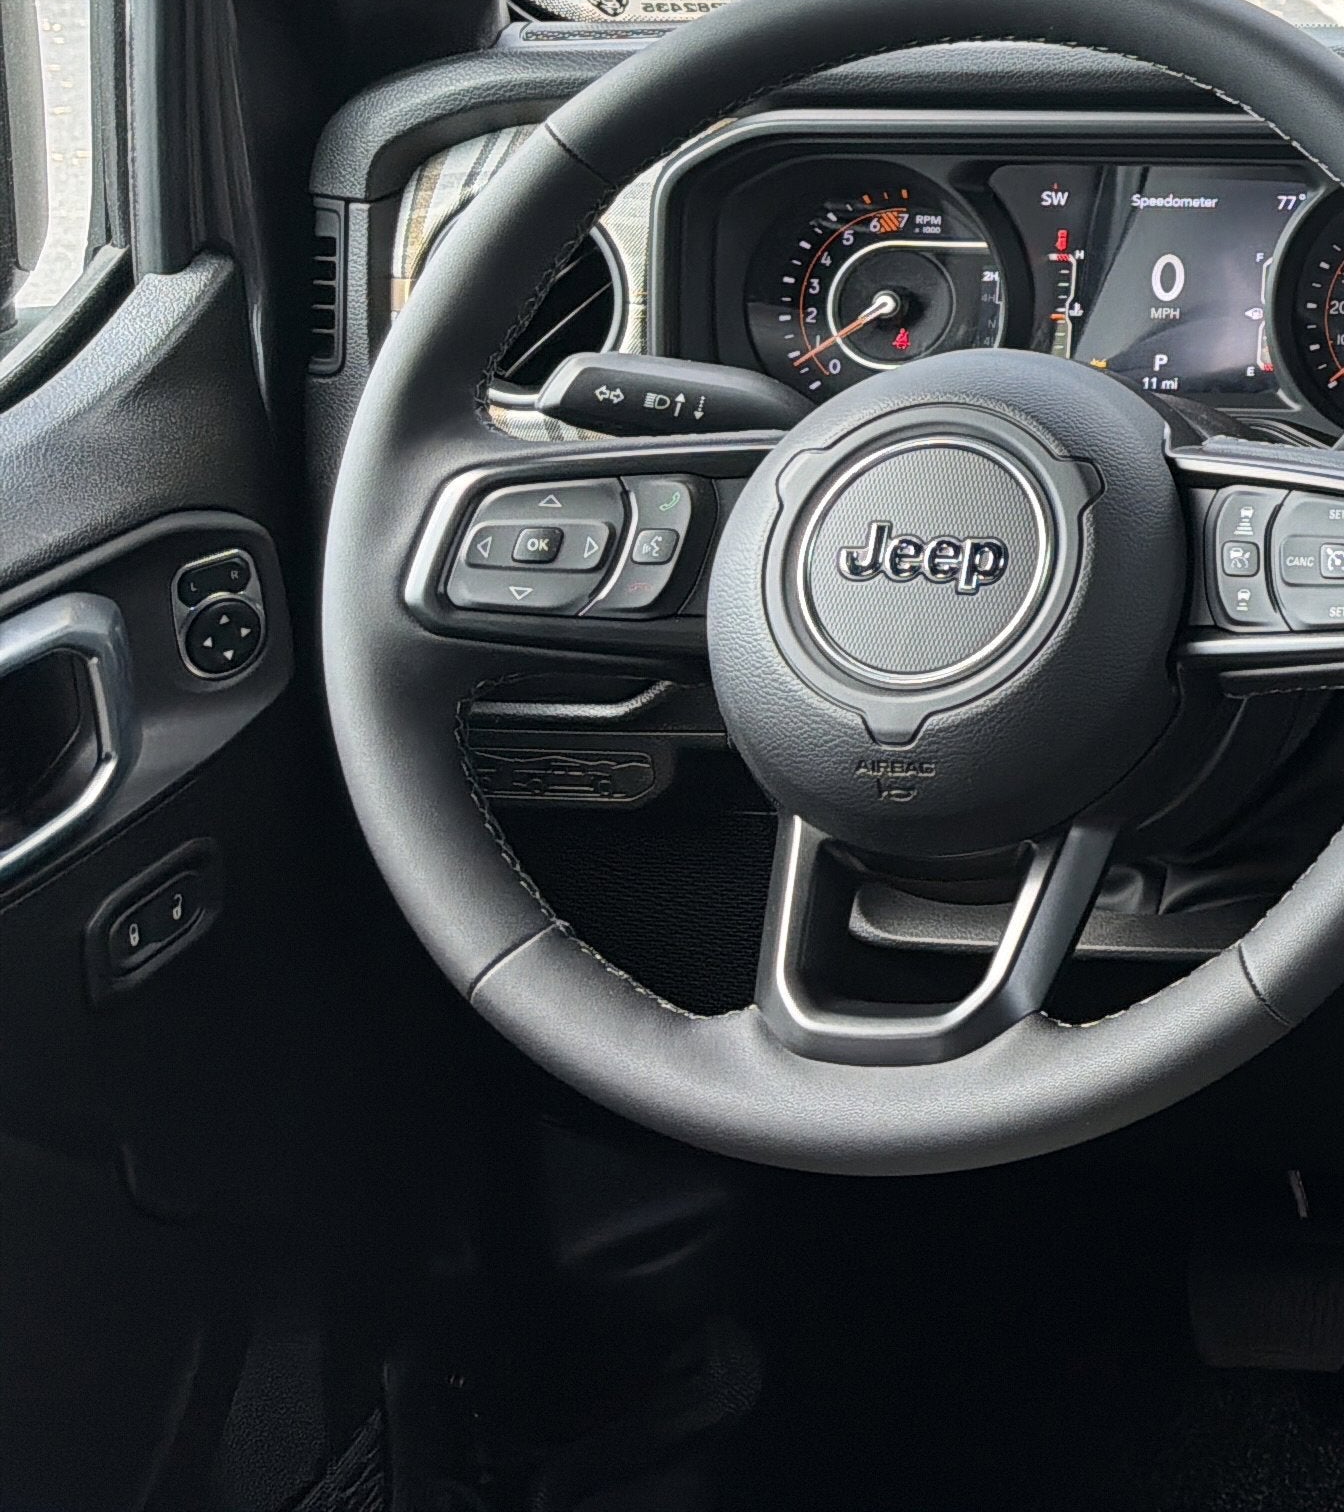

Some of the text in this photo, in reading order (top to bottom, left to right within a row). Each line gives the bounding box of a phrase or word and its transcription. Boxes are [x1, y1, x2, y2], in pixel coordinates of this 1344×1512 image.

[1041, 191, 1068, 206] SW
[1131, 194, 1218, 209] Speedometer
[870, 219, 880, 232] 6
[899, 214, 909, 228] 7
[916, 215, 941, 225] RPM
[843, 230, 854, 245] 5
[821, 252, 832, 266] 4
[1152, 254, 1185, 301] 0
[809, 279, 820, 294] 3
[806, 308, 817, 322] 2
[1150, 308, 1180, 319] MPH
[829, 359, 841, 374] 0
[1154, 355, 1168, 371] P
[1142, 377, 1178, 389] 11 mi
[527, 538, 549, 551] OK
[837, 520, 1009, 596] Jeep
[1286, 556, 1314, 567] CANC
[855, 760, 937, 777] AIRBAG
